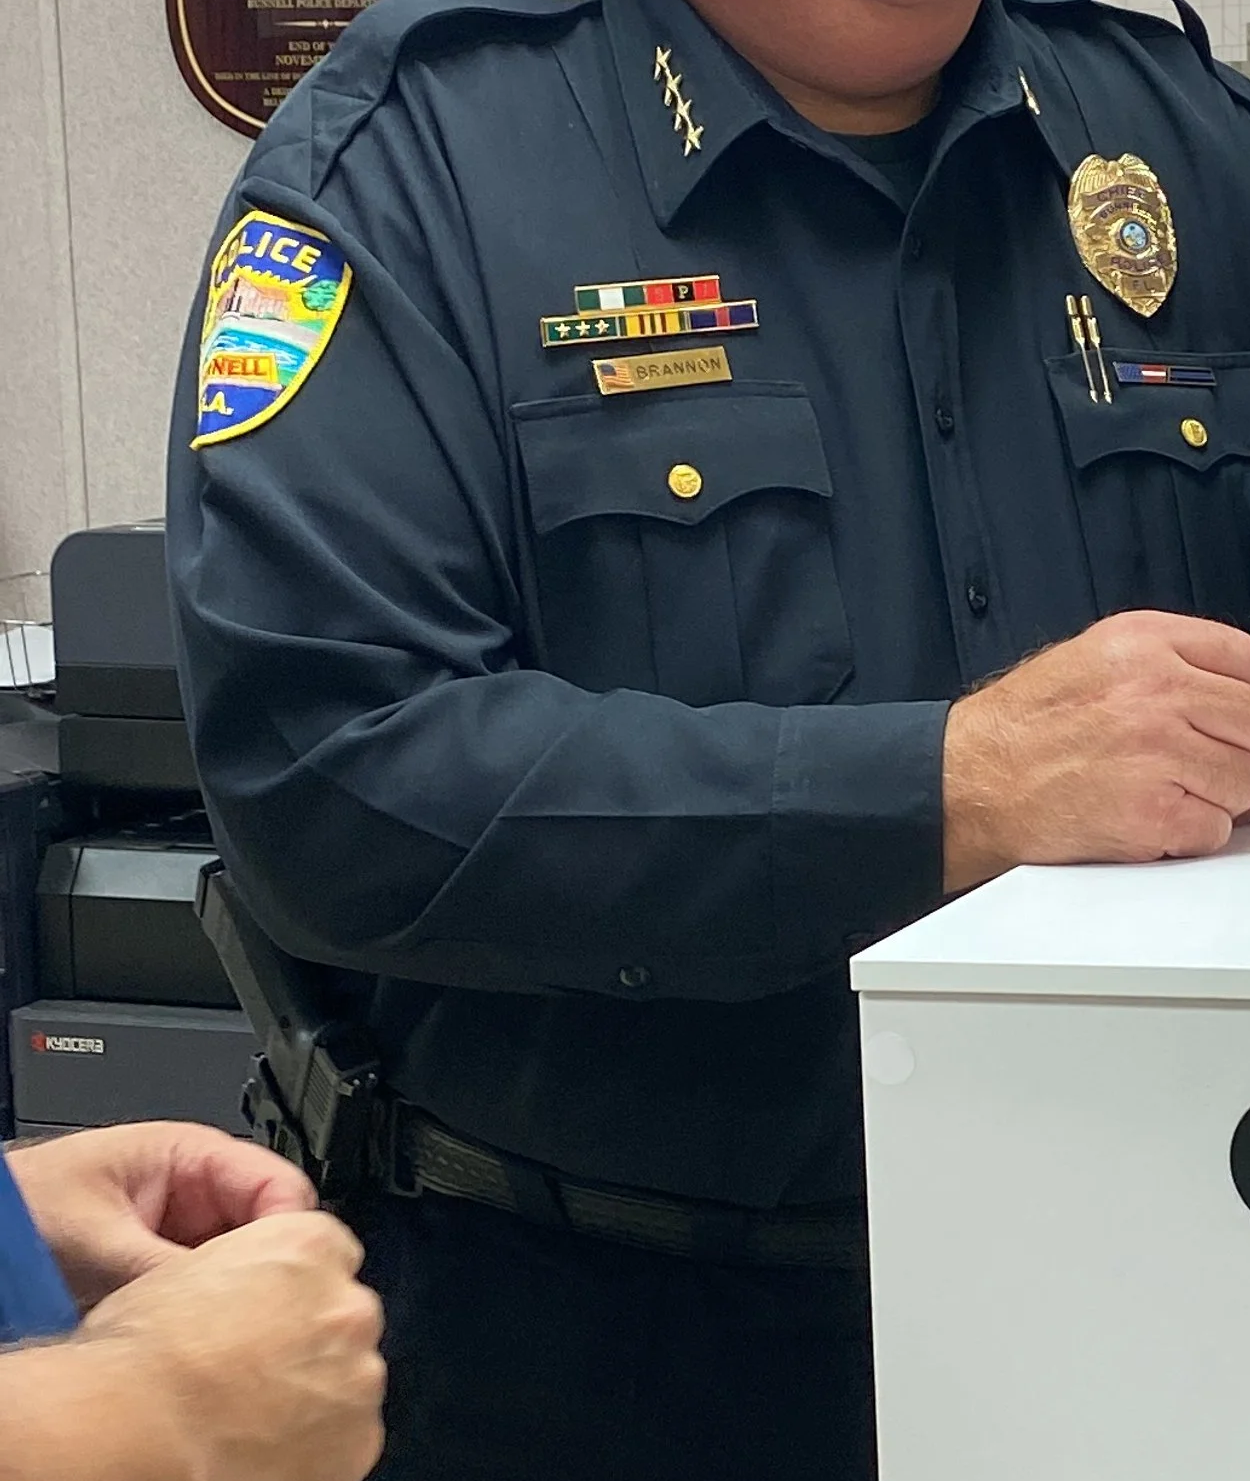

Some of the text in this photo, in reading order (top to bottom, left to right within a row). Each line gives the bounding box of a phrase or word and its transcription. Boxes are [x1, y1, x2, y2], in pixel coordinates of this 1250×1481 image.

[288, 41, 310, 52] END
[275, 54, 323, 67] NOVEM
[208, 357, 267, 376] NELL
[636, 357, 722, 379] BRANNON
[46, 1036, 105, 1054] KYOCERA
